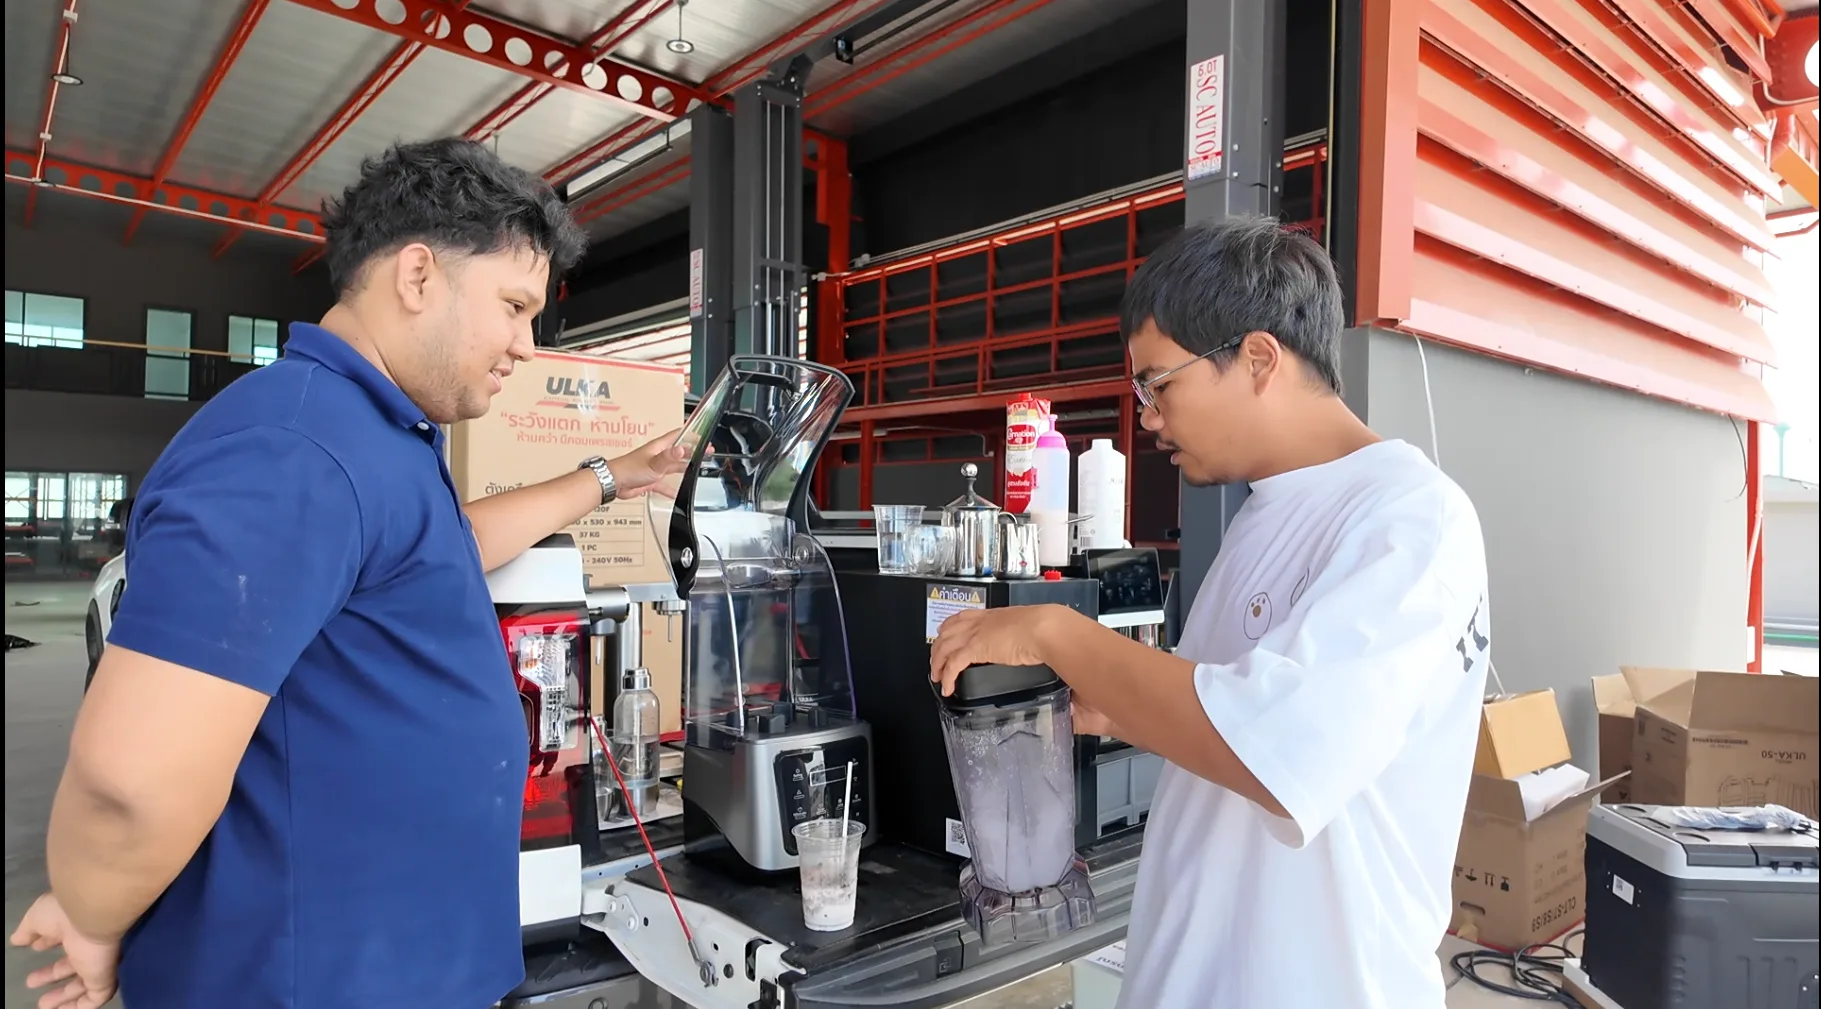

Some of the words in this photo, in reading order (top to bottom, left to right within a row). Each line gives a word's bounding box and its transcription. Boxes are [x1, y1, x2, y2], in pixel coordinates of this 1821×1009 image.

[1196, 74, 1218, 101] SC
[1195, 105, 1217, 155] AUTO
[590, 518, 605, 526] 530
[613, 518, 628, 526] 943
[1761, 749, 1807, 760] ULKA-50
